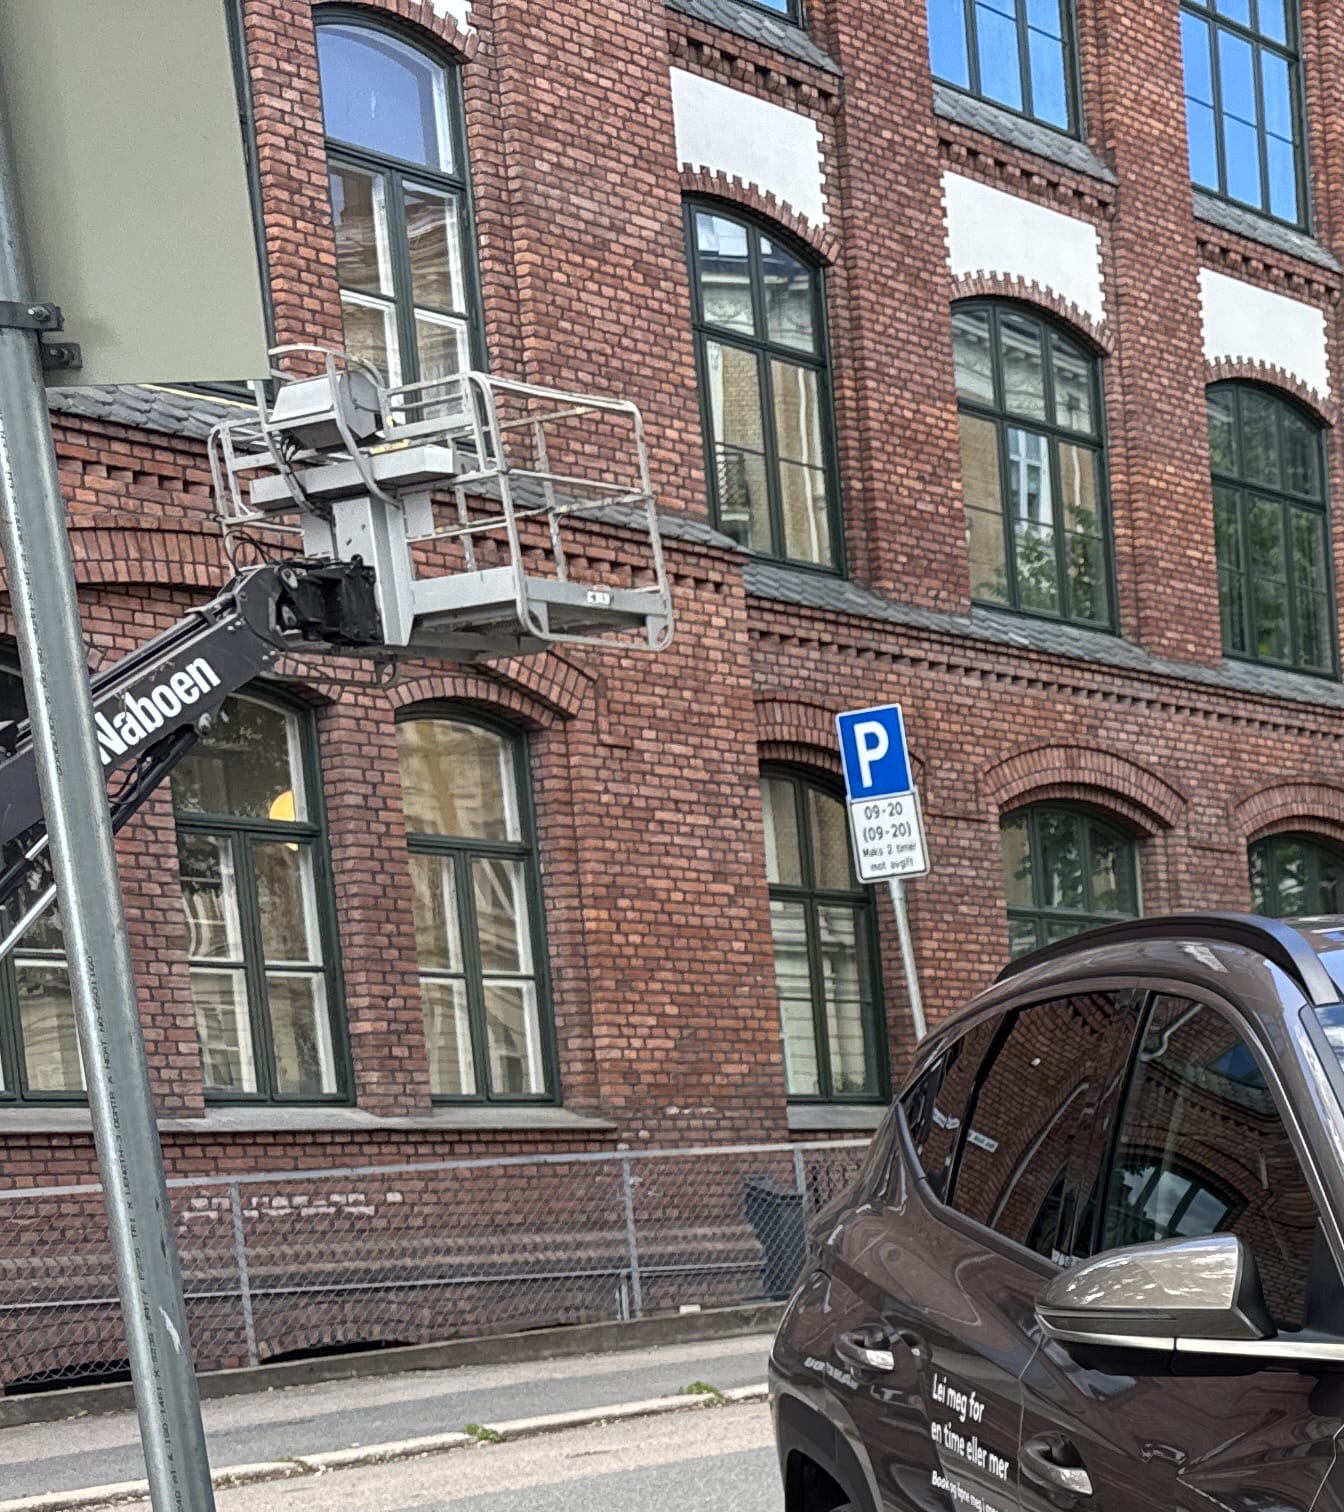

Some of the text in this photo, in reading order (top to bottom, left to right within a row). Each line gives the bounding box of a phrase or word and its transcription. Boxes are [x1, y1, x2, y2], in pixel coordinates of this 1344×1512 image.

[854, 720, 889, 788] P
[887, 844, 893, 854] 2
[932, 1372, 984, 1423] Lei meg for
[931, 1421, 1009, 1480] en time eller mer
[932, 1470, 950, 1490] Book
